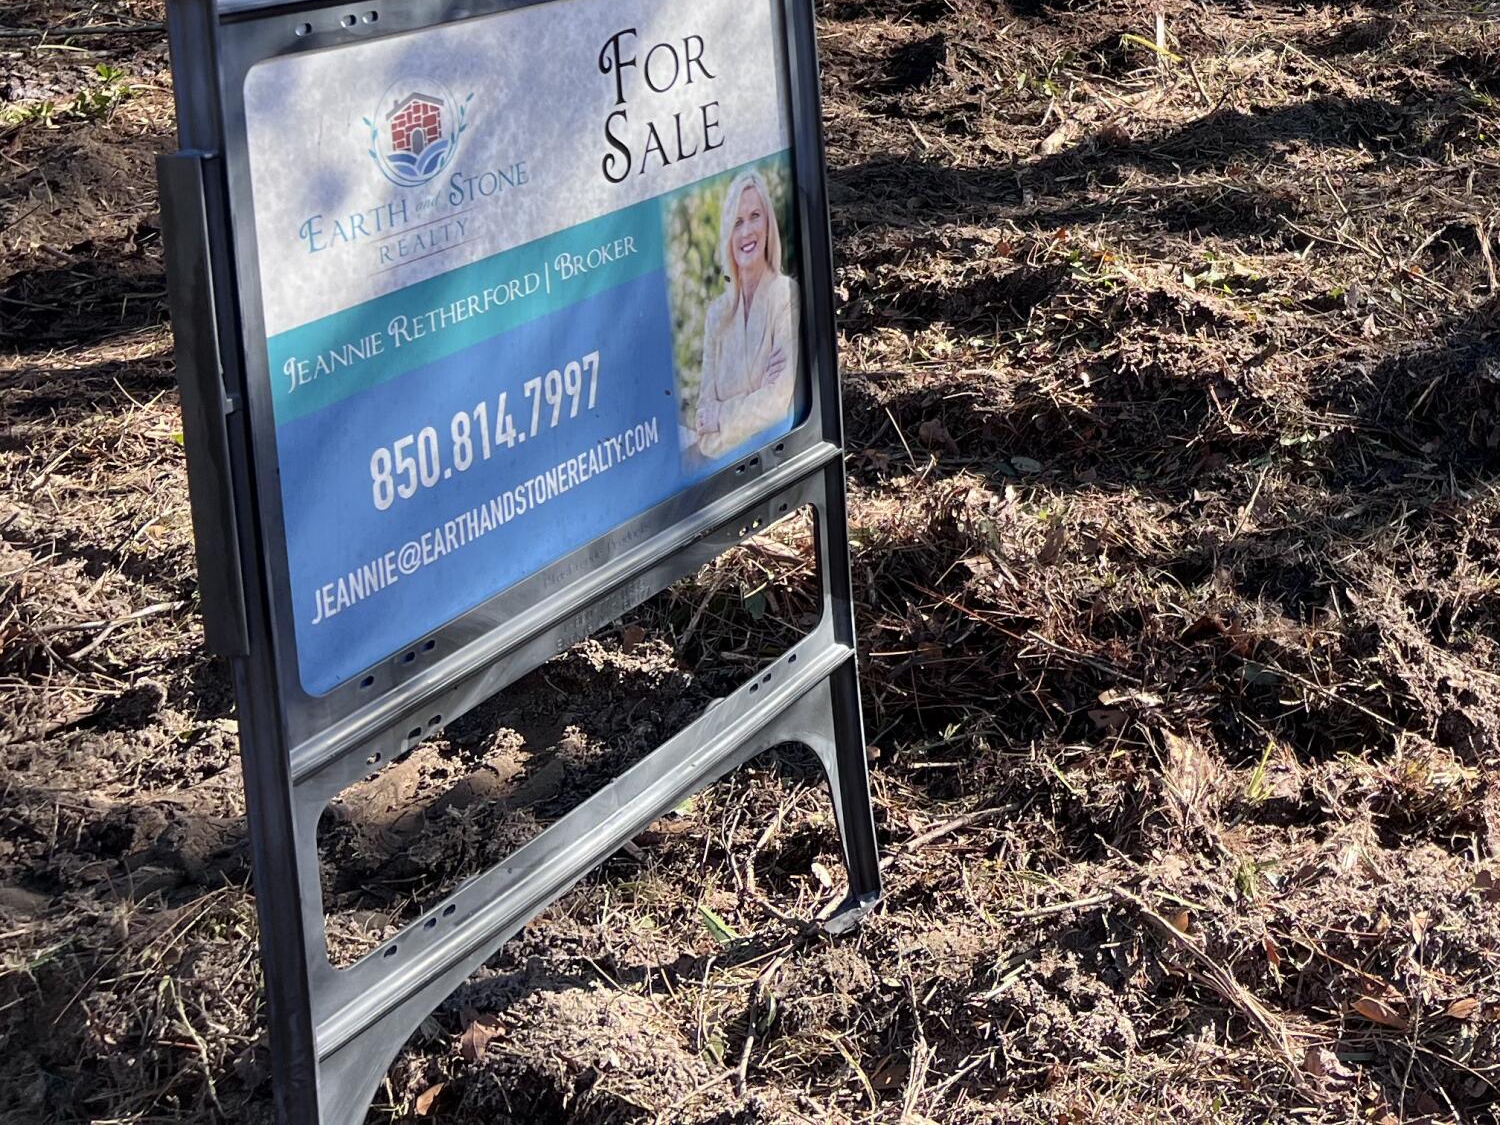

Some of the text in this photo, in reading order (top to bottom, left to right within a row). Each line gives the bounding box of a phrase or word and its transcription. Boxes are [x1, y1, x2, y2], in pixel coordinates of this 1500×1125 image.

[599, 28, 716, 105] FOR
[602, 101, 725, 183] SALE
[299, 161, 530, 254] EARTH and STONE
[379, 218, 469, 265] REALTY
[283, 235, 638, 394] JEANNIE RETHERFORD BROKER
[370, 351, 600, 511] 850.814.7997
[312, 417, 659, 624] JEANNIE@EARTHANDSTONEREALTY.COM
